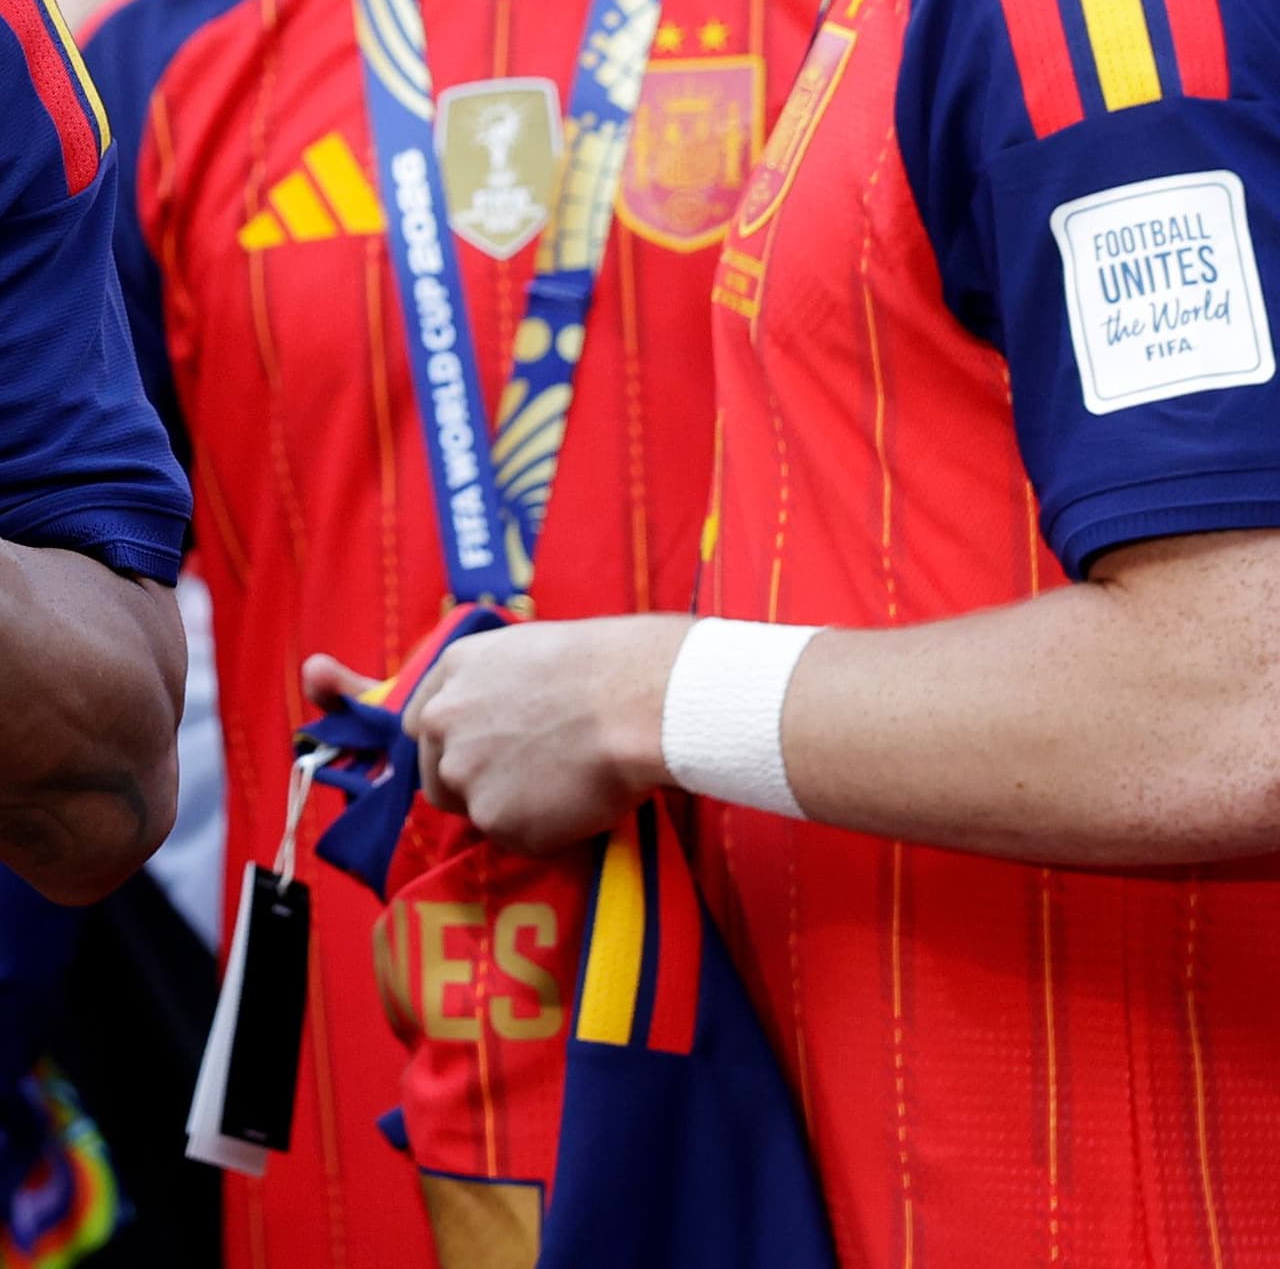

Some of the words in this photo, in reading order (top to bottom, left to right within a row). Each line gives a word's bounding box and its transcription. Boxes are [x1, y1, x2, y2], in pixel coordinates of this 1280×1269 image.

[391, 147, 444, 276] 2026
[1093, 213, 1211, 261] FOOTBALL
[1098, 245, 1218, 305] UNITES
[413, 274, 457, 352] CUP
[1101, 309, 1146, 347] the
[1149, 289, 1231, 333] World
[1145, 338, 1193, 361] FIFA
[426, 350, 479, 490] WORLD
[449, 483, 494, 571] FIFA
